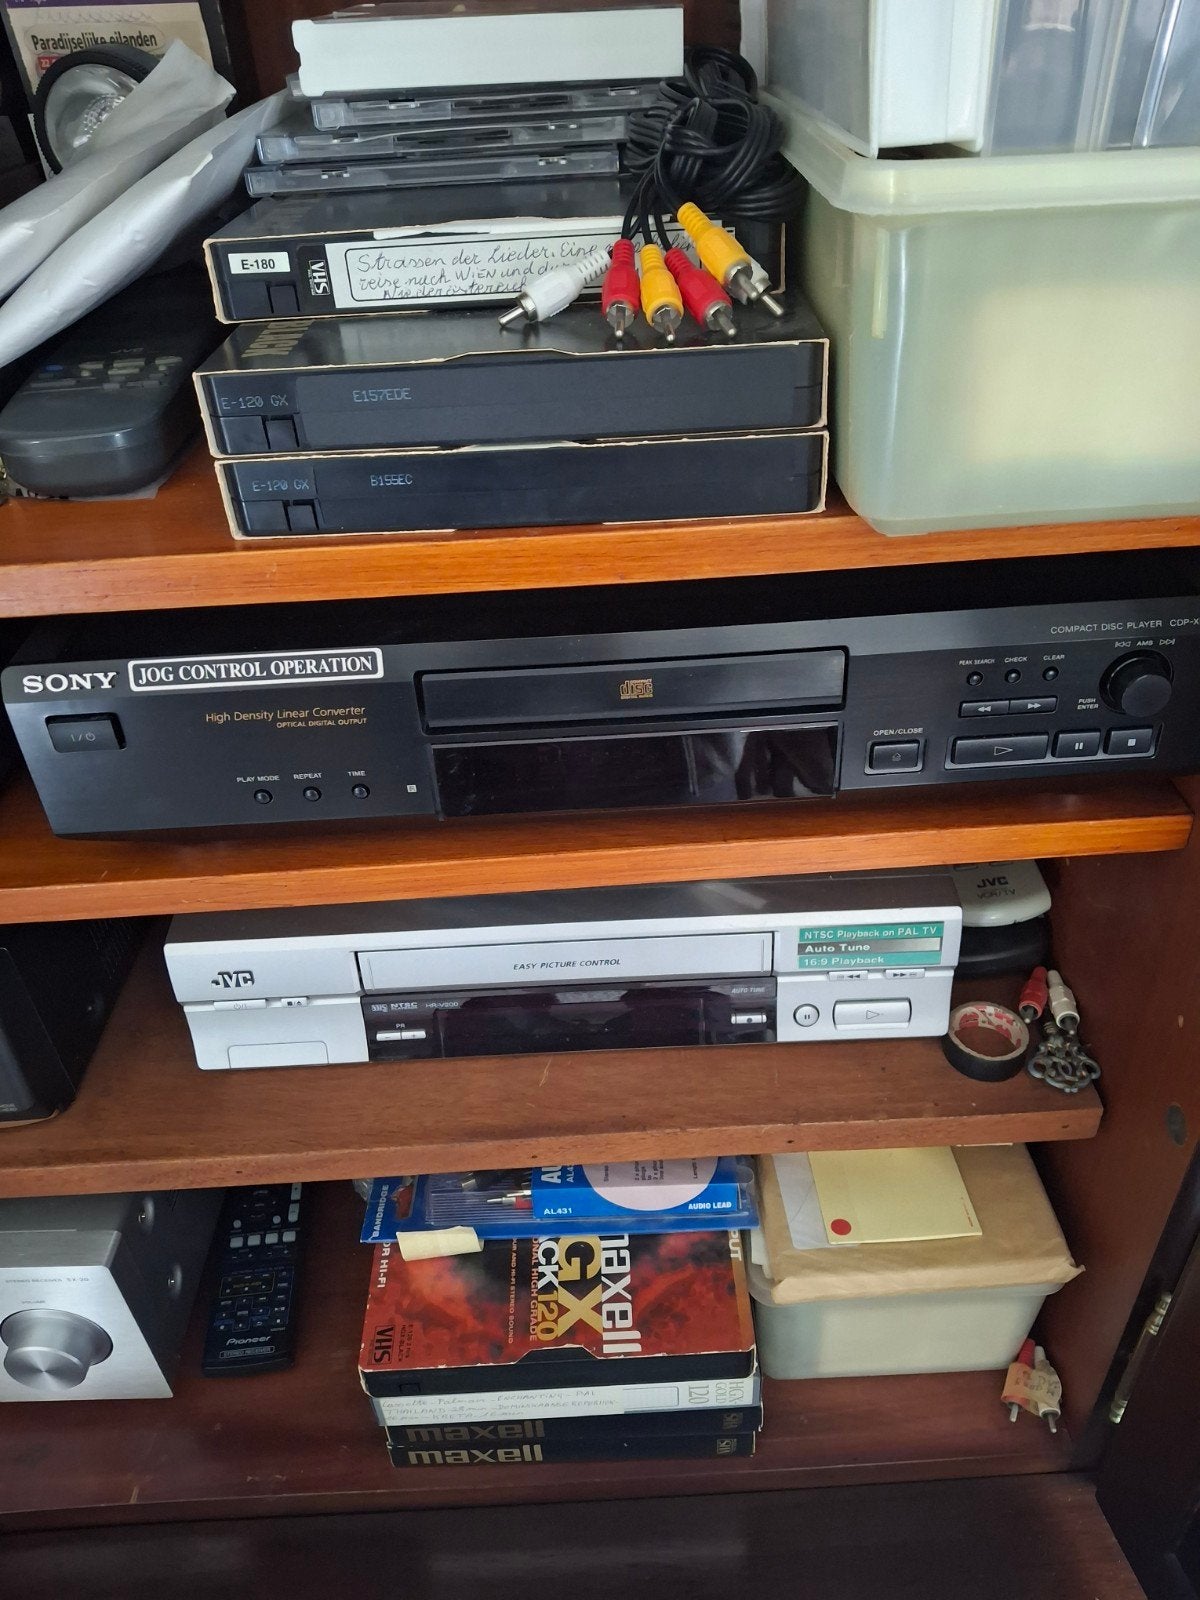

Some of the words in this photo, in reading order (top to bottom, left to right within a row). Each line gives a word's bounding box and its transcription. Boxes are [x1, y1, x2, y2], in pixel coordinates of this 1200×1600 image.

[31, 32, 106, 53] Paradijselijke
[109, 30, 157, 47] eilanden
[241, 258, 275, 270] E-180
[357, 251, 447, 273] Strassen
[452, 249, 480, 265] der
[311, 260, 330, 295] VHS
[405, 268, 451, 286] nach
[500, 261, 534, 279] und
[222, 396, 264, 409] E-120
[271, 395, 288, 406] GX
[253, 480, 287, 491] E-120
[294, 479, 310, 490] GX
[1050, 624, 1097, 634] COMPACT
[1101, 622, 1123, 631] DISC
[1127, 620, 1162, 629] PLAYER
[138, 665, 174, 685] JOG
[179, 660, 267, 681] CONTROL
[270, 656, 374, 676] OPERATION
[22, 671, 117, 693] SONY
[206, 712, 231, 724] High
[234, 709, 273, 721] Density
[277, 709, 310, 719] Linear
[312, 706, 366, 717] Converter
[276, 721, 306, 729] OPTICAL
[338, 718, 367, 726] OUTPUT
[873, 727, 924, 736] OPEN/CLOSE
[293, 772, 322, 780] REPEAT
[977, 876, 1008, 888] JVC
[804, 930, 834, 940] NTSC
[837, 928, 879, 939] Playback
[882, 929, 895, 937] on
[897, 927, 919, 936] PAL
[922, 926, 937, 935] TV
[805, 944, 835, 953] Auto
[839, 943, 870, 952] Tune
[513, 963, 537, 971] EASY
[540, 960, 577, 969] PICTURE
[579, 958, 621, 967] CONTROL
[804, 957, 828, 967] 16:9
[831, 956, 884, 967] Playback
[211, 970, 255, 989] JVC
[566, 1165, 575, 1183] AL4
[372, 1184, 389, 1237] BANDRIDGE
[688, 1202, 711, 1210] AUDIO
[537, 1237, 560, 1289] CK
[377, 1260, 389, 1288] HI-FI
[530, 1268, 538, 1297] HIGH
[558, 1235, 602, 1338] GX
[529, 1299, 538, 1342] GRADE
[536, 1290, 559, 1341] 120
[226, 1336, 272, 1346] Pioneer
[374, 1326, 394, 1364] VHS
[688, 1384, 710, 1404] 120
[406, 1420, 546, 1442] maxell
[408, 1444, 543, 1464] maxell
